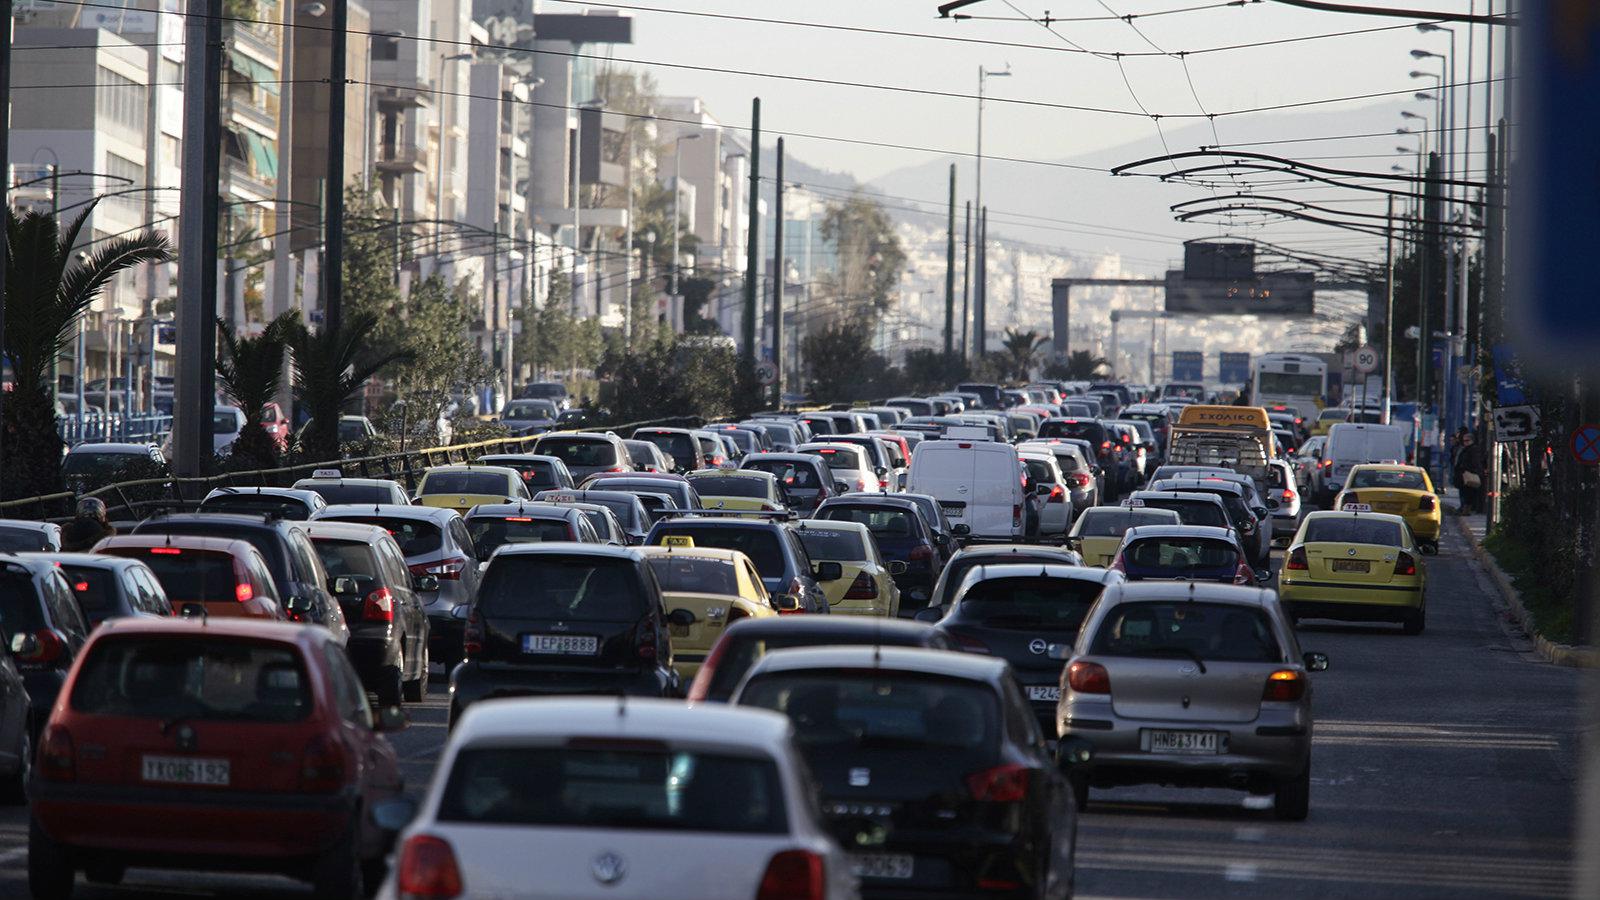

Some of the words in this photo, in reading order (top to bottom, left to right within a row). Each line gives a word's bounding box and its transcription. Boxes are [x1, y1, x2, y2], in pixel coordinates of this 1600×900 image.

[1359, 354, 1374, 365] 90
[757, 367, 773, 379] 90
[1199, 413, 1255, 421] ΣΧΟΛΙΚΟ
[550, 495, 571, 503] TAXI
